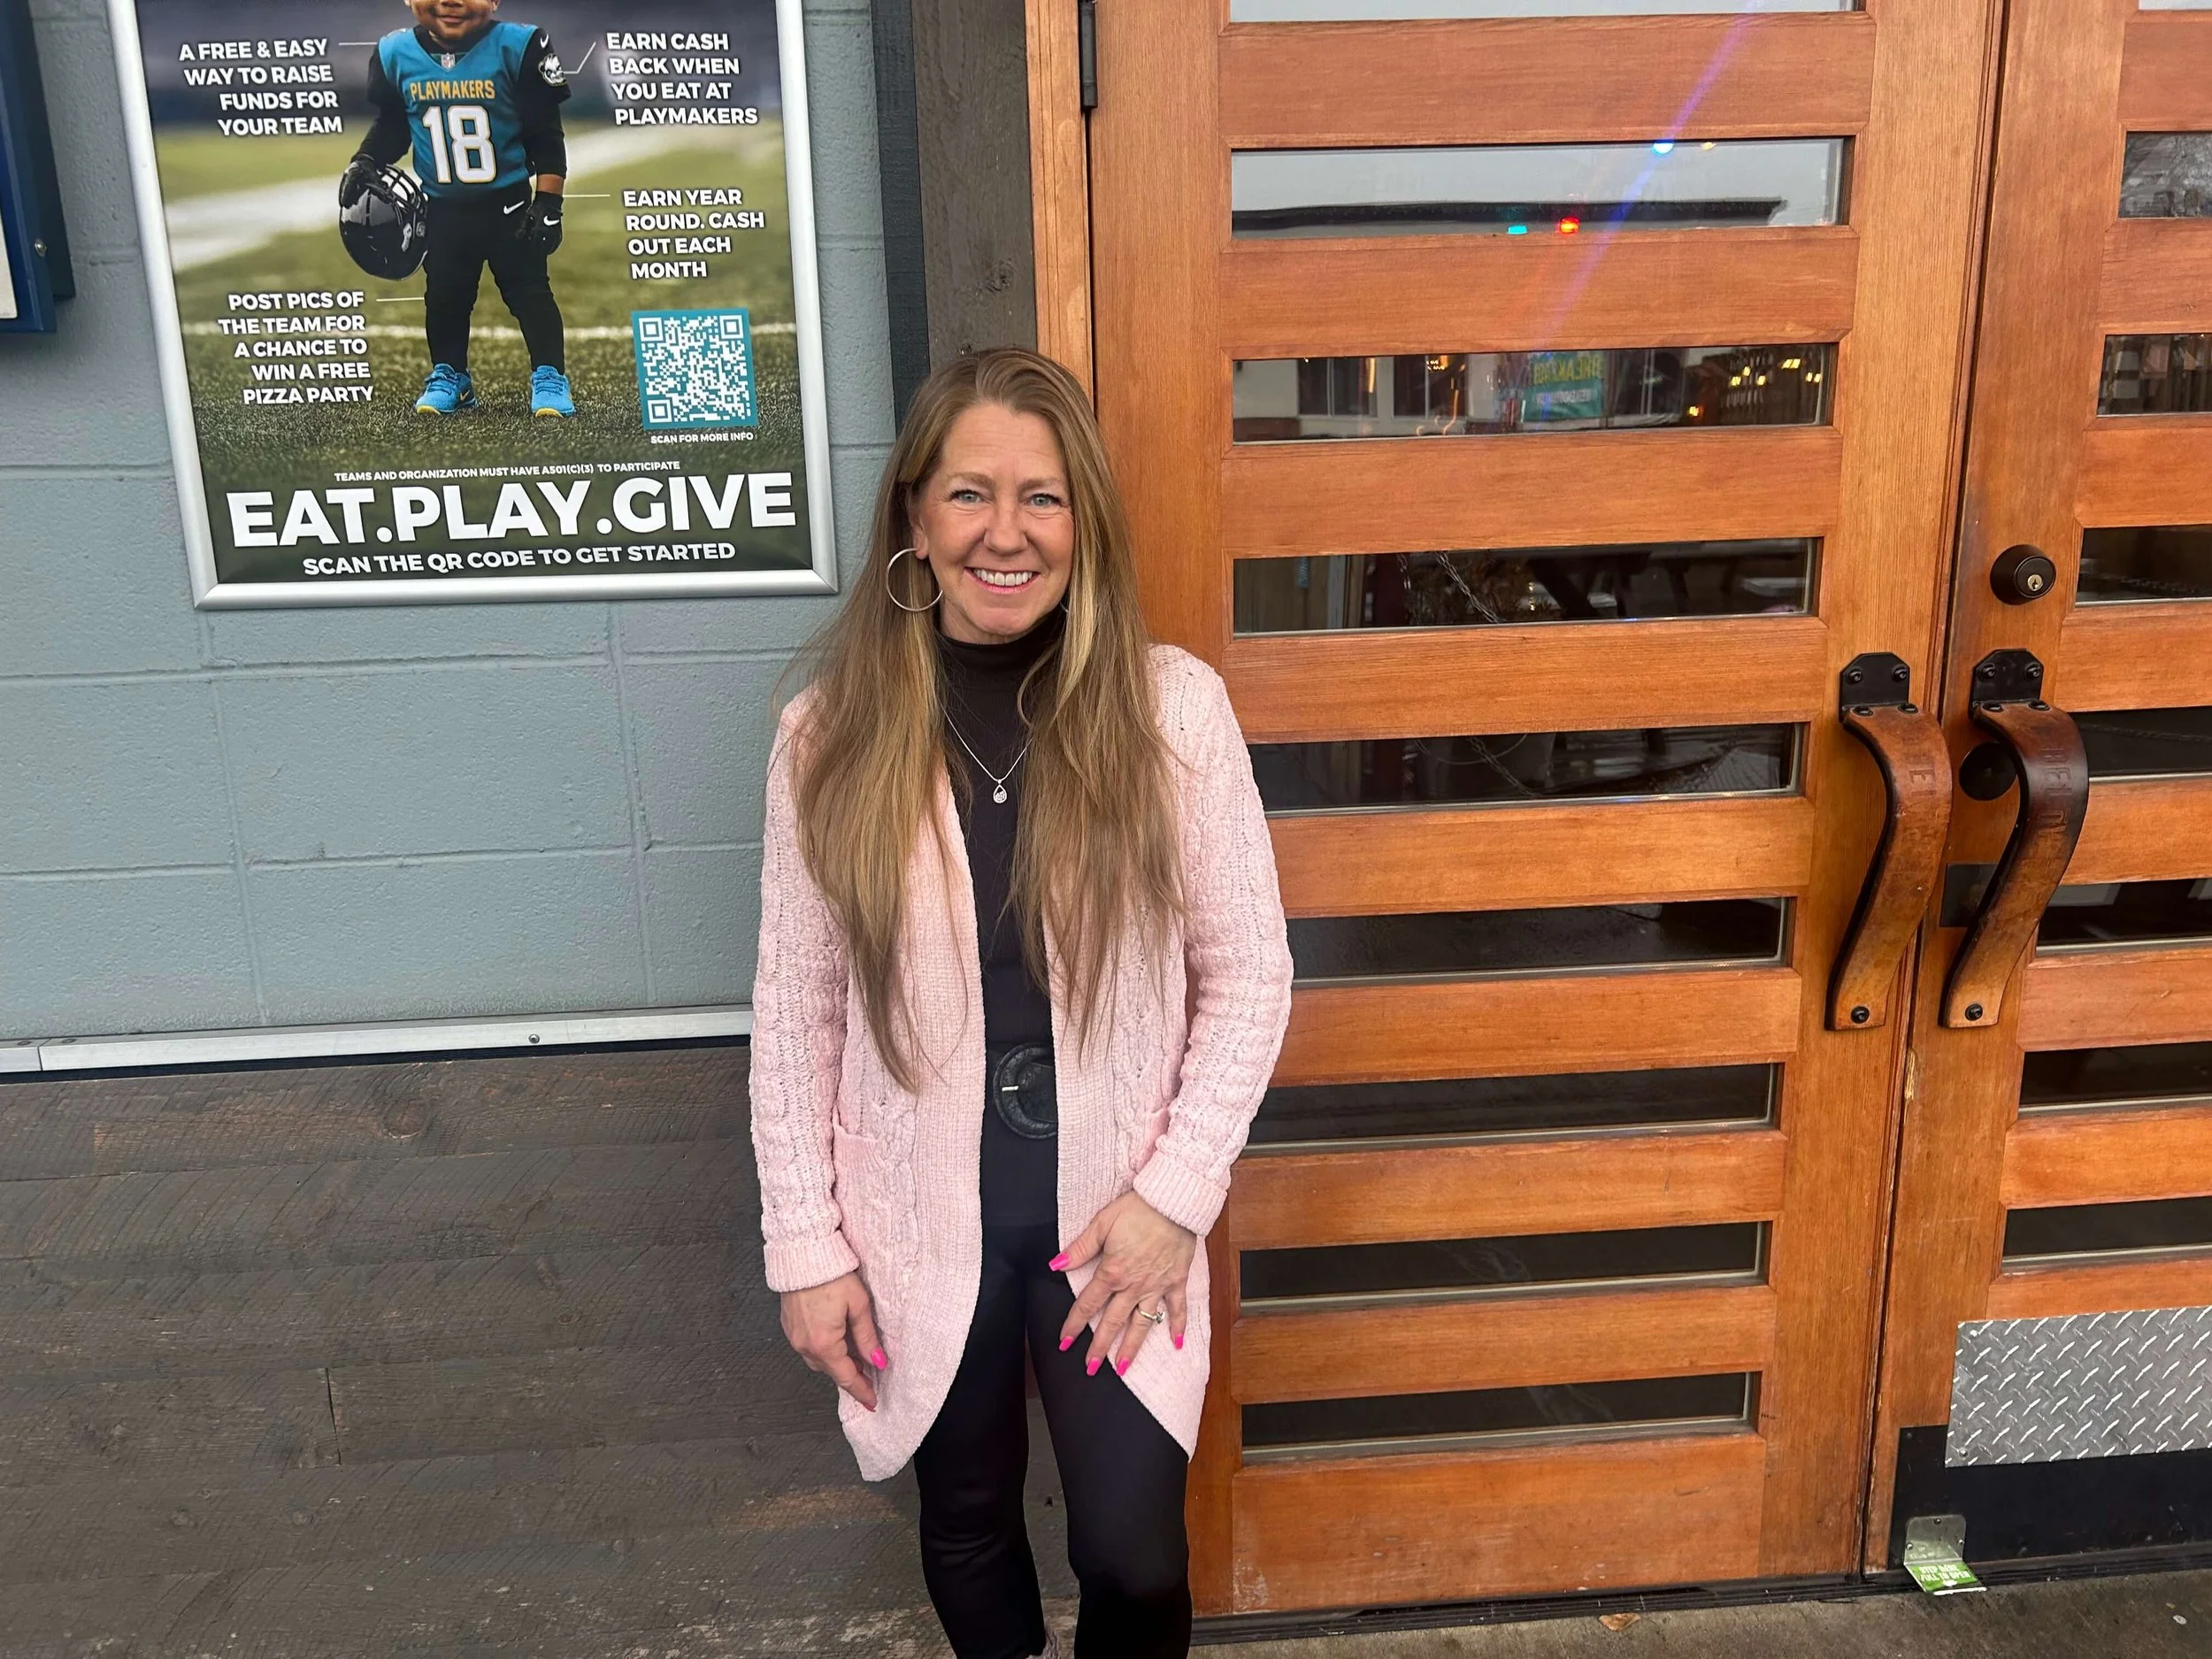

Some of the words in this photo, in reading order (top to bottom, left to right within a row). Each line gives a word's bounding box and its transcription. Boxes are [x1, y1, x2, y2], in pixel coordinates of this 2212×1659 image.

[179, 43, 196, 62] A
[198, 41, 251, 60] FREE
[257, 40, 271, 59] &
[274, 38, 327, 58] EASY
[606, 32, 667, 50] EARN
[671, 33, 728, 50] CASH
[184, 67, 234, 86] WAY
[237, 66, 267, 85] TO
[272, 65, 333, 83] RAISE
[609, 58, 669, 74] BACK
[672, 58, 740, 74] WHEN
[219, 92, 293, 111] FUNDS
[296, 90, 339, 109] FOR
[410, 80, 495, 101] PLAYMAKERS
[611, 83, 657, 100] YOU
[661, 82, 701, 99] EAT
[705, 82, 732, 99] AT
[218, 117, 279, 136] YOUR
[281, 116, 342, 134] TEAM
[615, 107, 758, 125] PLAYMAKERS
[422, 105, 497, 184] 18
[623, 190, 681, 207] EARN
[685, 188, 742, 205] YEAR
[626, 213, 705, 231] ROUND.
[708, 211, 764, 228] CASH
[628, 238, 671, 256] OUT
[675, 236, 731, 254] EACH
[631, 261, 707, 279] MONTH
[228, 293, 283, 311] POST
[287, 292, 334, 309] PICS
[336, 291, 365, 308] OF
[218, 319, 261, 334] THE
[262, 317, 321, 334] TEAM
[325, 315, 365, 332] FOR
[234, 342, 250, 358] A
[253, 340, 337, 357] CHANCE
[339, 339, 367, 355] TO
[251, 365, 296, 380] WIN
[299, 364, 315, 380] A
[318, 362, 371, 379] FREE
[242, 388, 304, 405] PIZZA
[306, 386, 373, 403] PARTY
[650, 435, 677, 444] SCAN
[700, 434, 729, 442] MORE
[730, 432, 754, 441] INFO
[334, 472, 373, 482] TEAMS
[373, 471, 397, 480] AND
[398, 468, 478, 480] ORGANIZATION
[479, 467, 509, 477] MUST
[511, 465, 540, 476] HAVE
[597, 464, 611, 472] TO
[613, 461, 680, 472] PARTICIPATE
[226, 472, 796, 547] EAT.PLAY.GIVE
[303, 556, 372, 575] SCAN
[373, 554, 424, 572] THE
[427, 553, 465, 573] QR
[466, 549, 535, 569] CODE
[537, 549, 572, 565] TO
[576, 546, 622, 564] GET
[627, 542, 736, 562] STARTED
